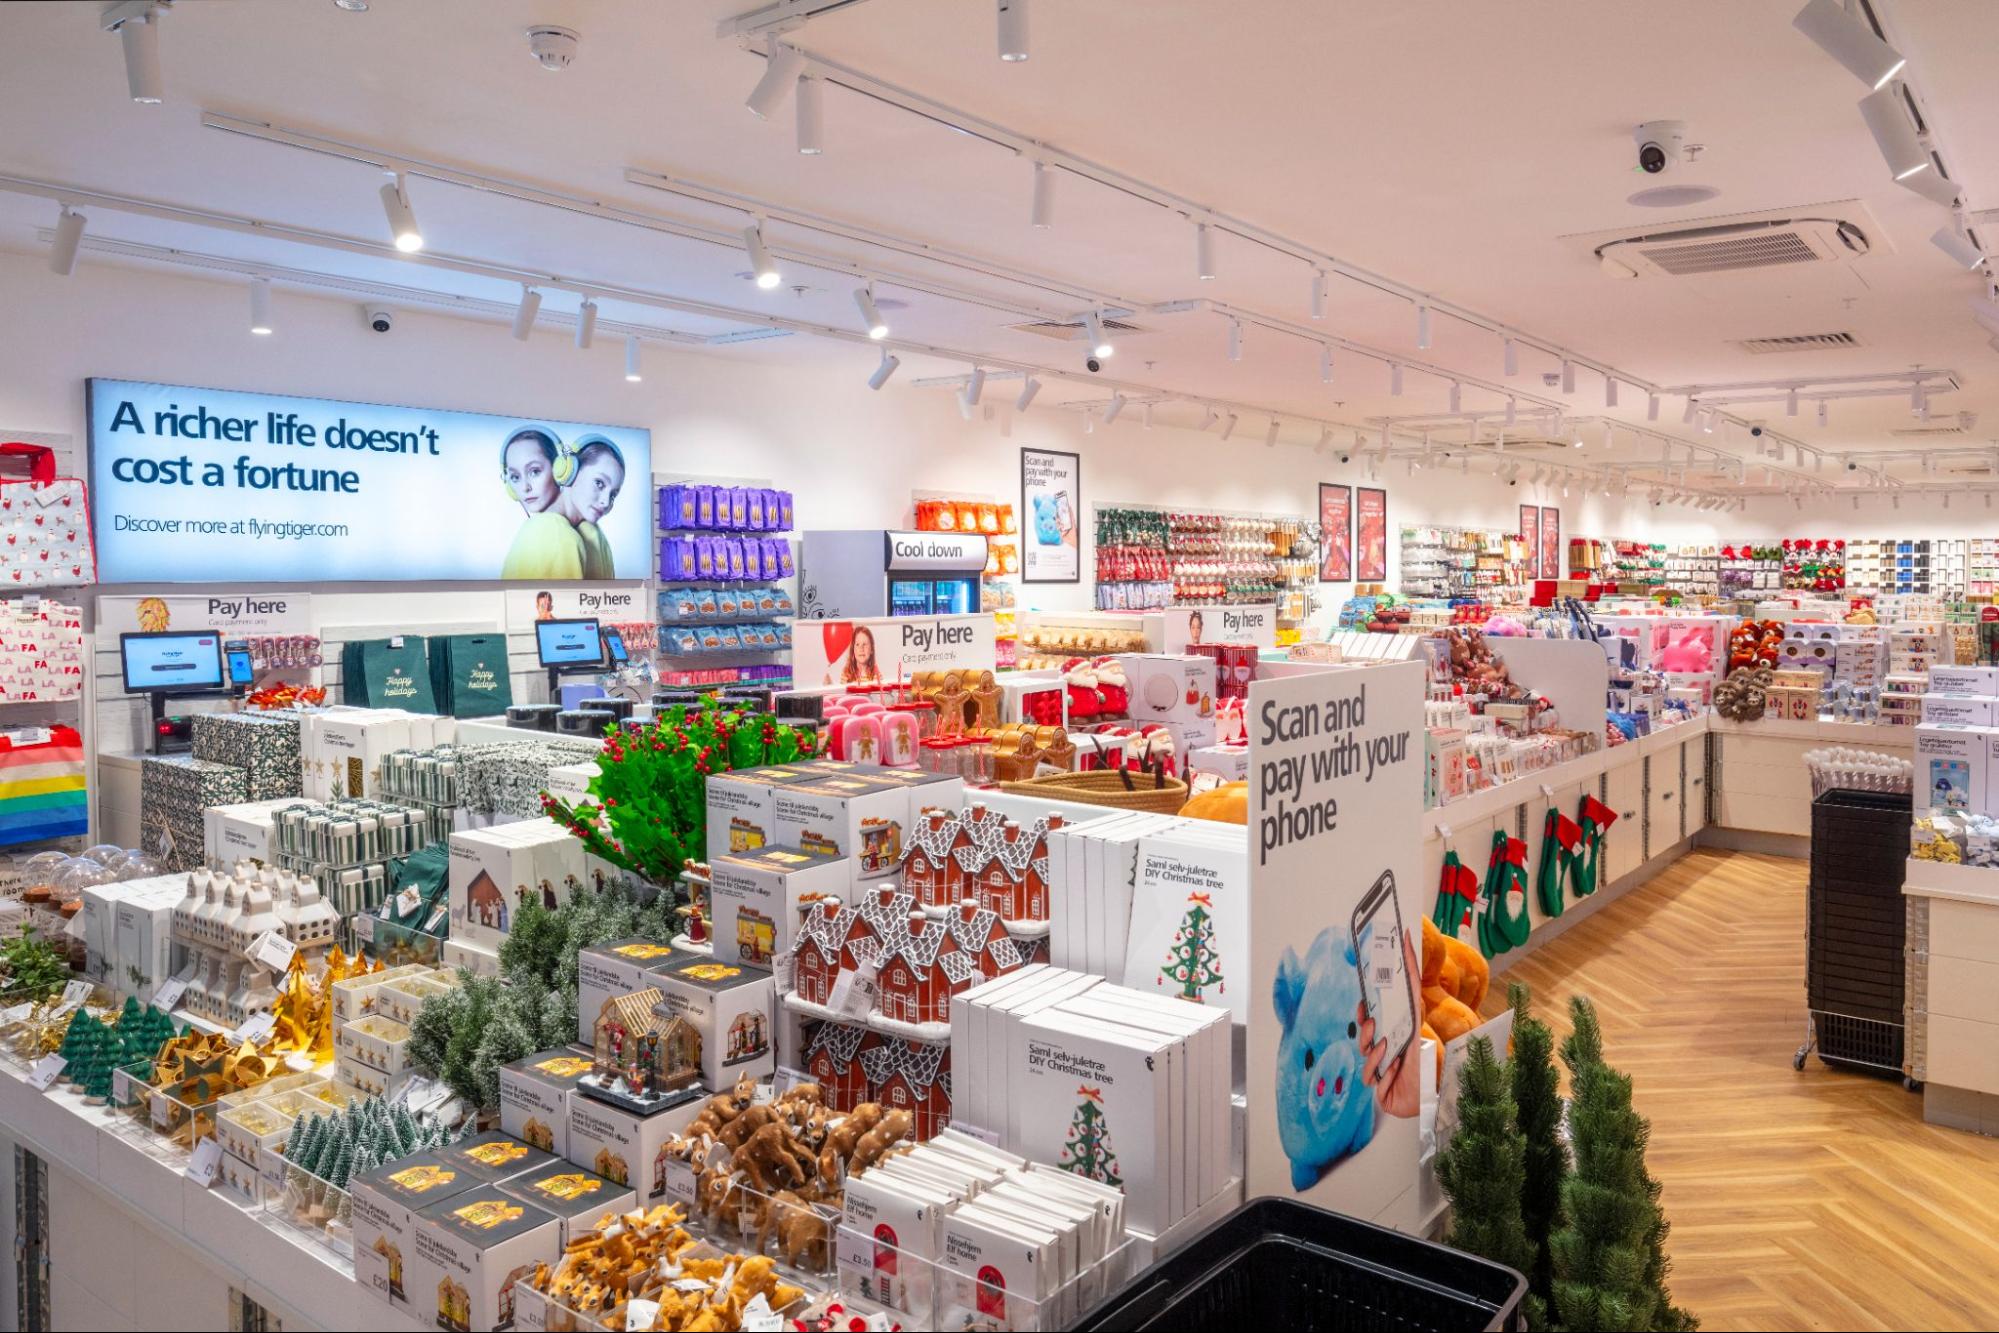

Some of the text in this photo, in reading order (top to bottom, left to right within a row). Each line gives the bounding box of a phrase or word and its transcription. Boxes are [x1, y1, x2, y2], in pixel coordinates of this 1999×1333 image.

[109, 400, 440, 455] A richer life doesn't
[1025, 455, 1054, 467] Scan and
[111, 455, 360, 493] cost a fortune
[1025, 467, 1067, 480] pay with your
[1025, 478, 1046, 488] phone
[114, 515, 349, 540] Discover more at flyingtiger.com
[895, 541, 963, 558] Cool down
[208, 597, 287, 619] Pay here
[580, 591, 631, 609] Pay here
[65, 620, 80, 628] FA
[1223, 610, 1264, 632] Pay here
[902, 621, 973, 652] Pay here
[21, 644, 37, 652] FA
[34, 660, 47, 669] FA
[386, 675, 413, 689] Happy
[470, 668, 494, 681] Happy
[384, 686, 418, 698] holidays
[468, 680, 498, 691] holidays
[22, 692, 37, 700] FA
[1261, 683, 1365, 746] Scan and
[1261, 730, 1410, 811] pay with your
[1261, 799, 1337, 866] phone
[1145, 858, 1218, 878] Saml selv-juletræ
[1145, 868, 1224, 889] DIY Christmas tree
[1029, 1043, 1051, 1057] Saml
[1053, 1051, 1106, 1071] selv-juletræ
[1029, 1054, 1114, 1085] DIY Christmas tree
[855, 1207, 874, 1221] home
[946, 1244, 956, 1254] Elf
[957, 1247, 977, 1262] home
[947, 1234, 982, 1254] Nissehjem
[853, 1253, 872, 1269] £3.50
